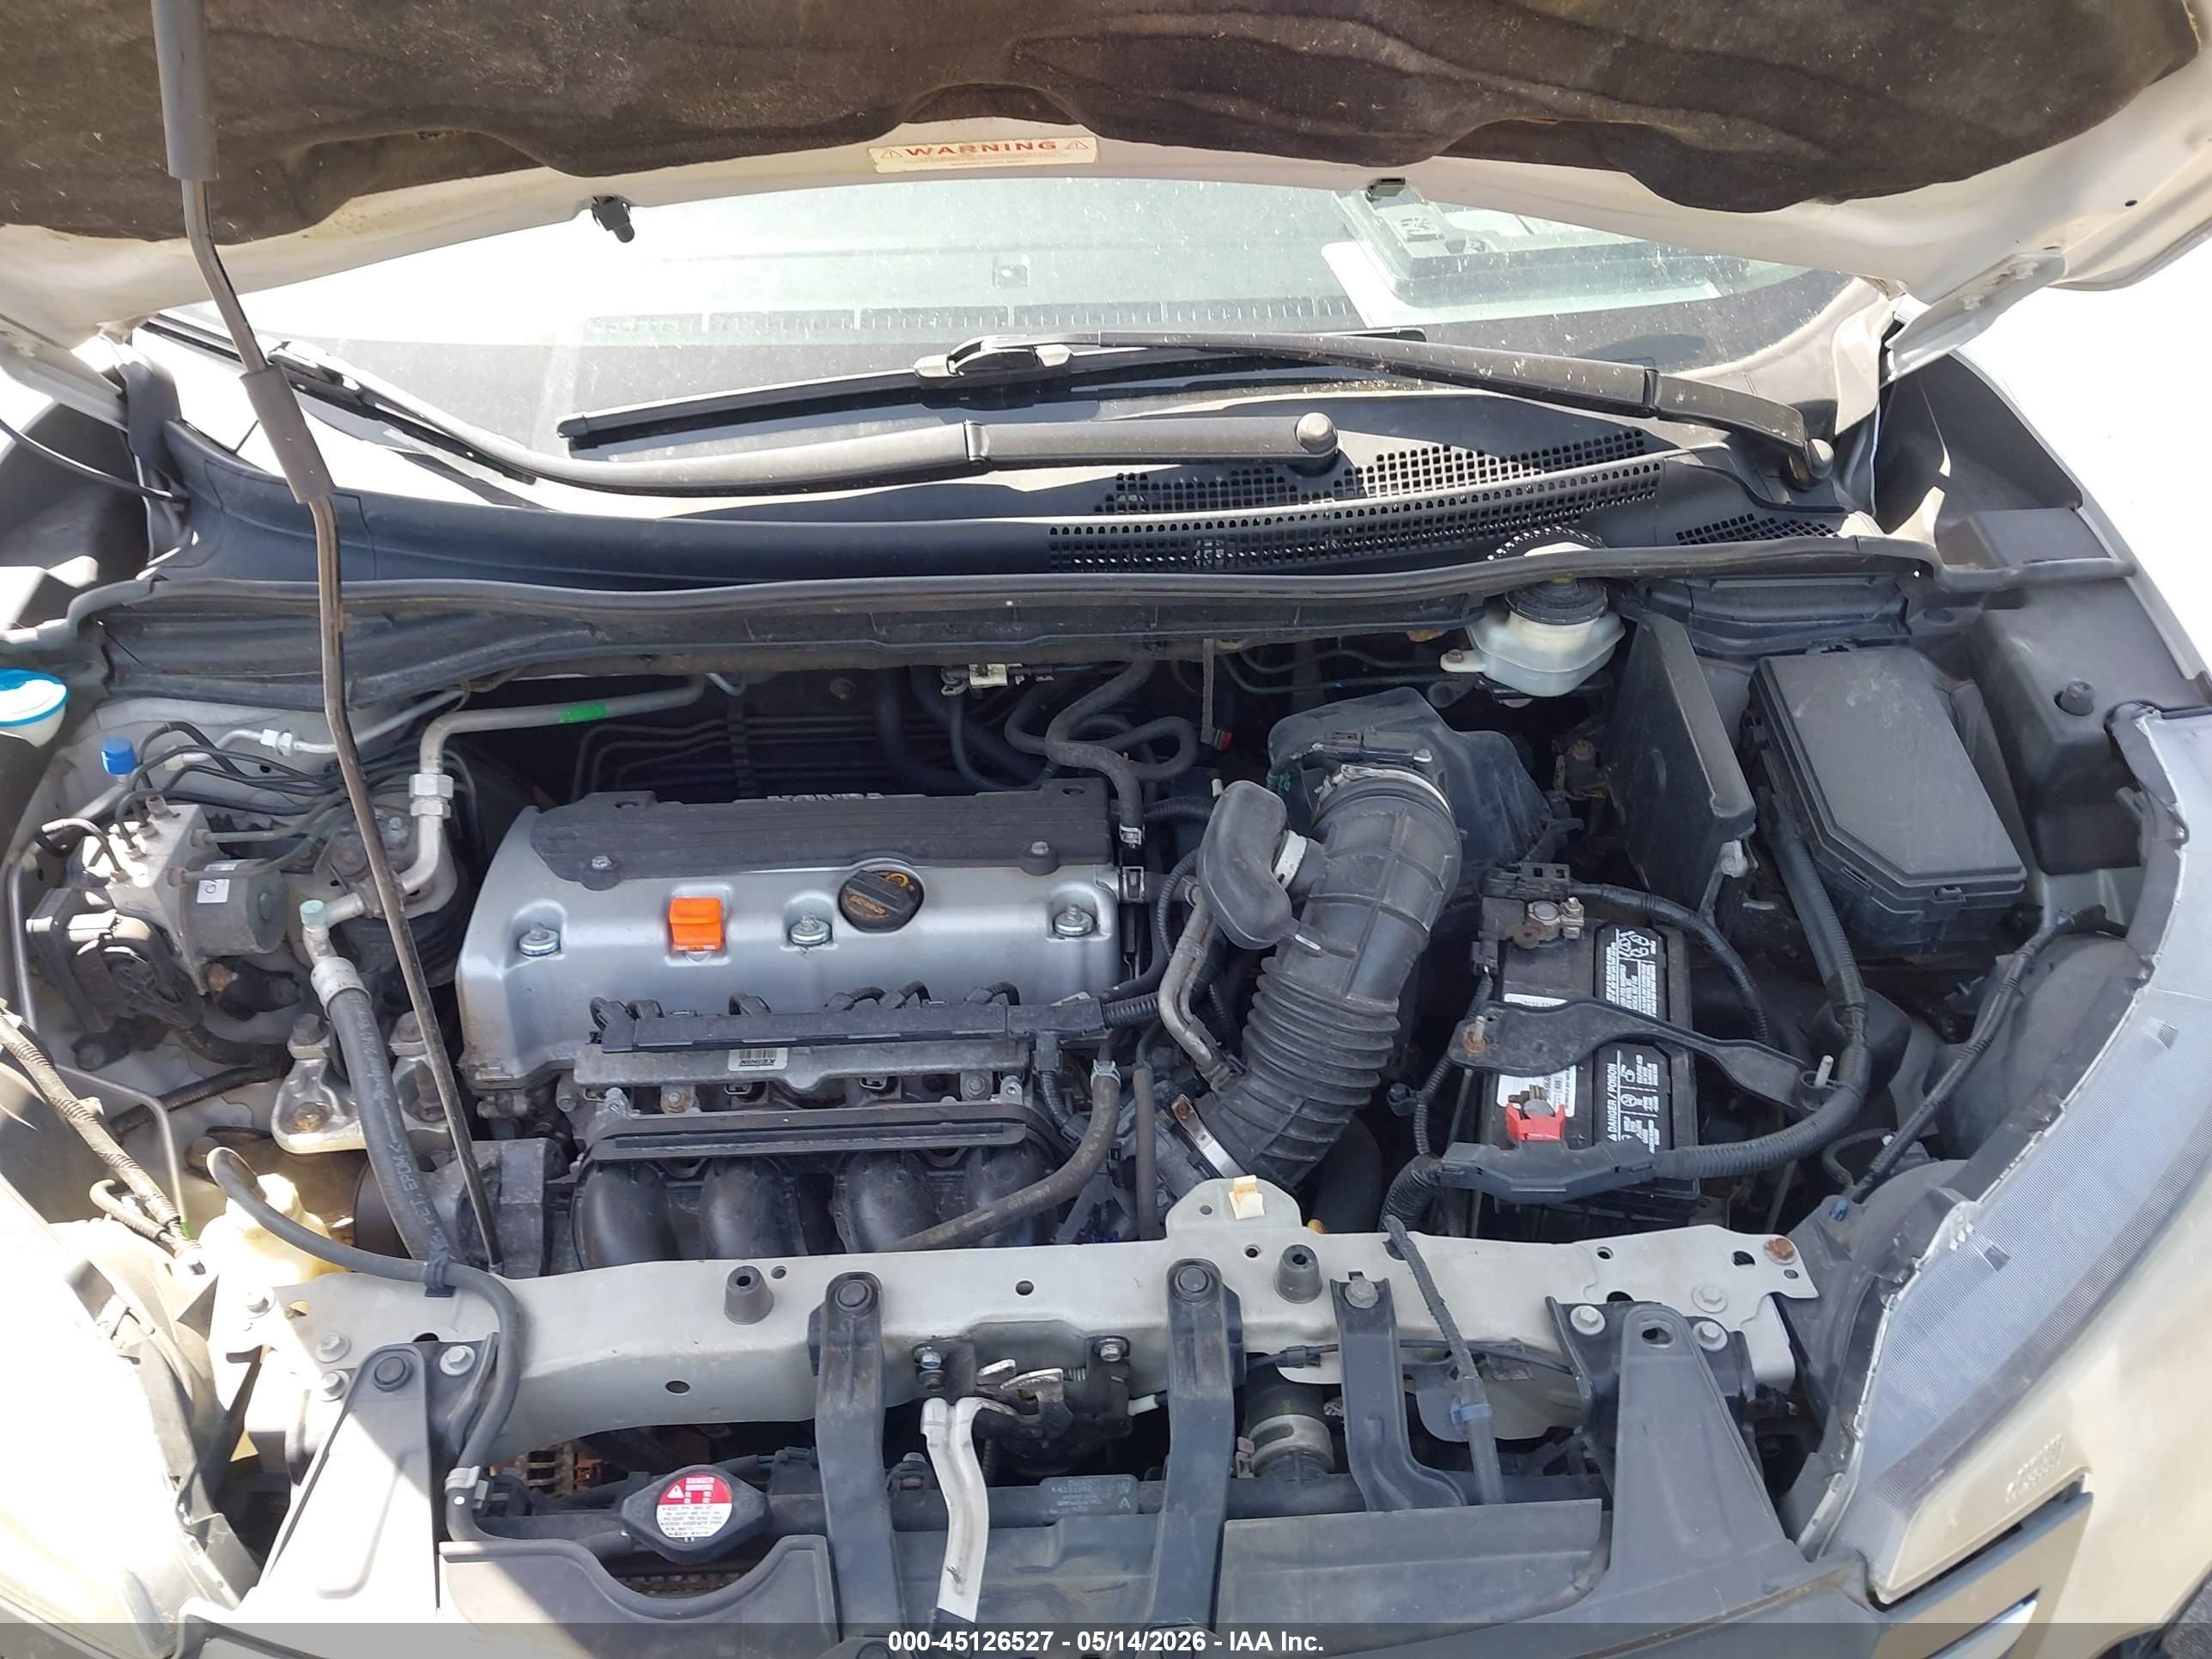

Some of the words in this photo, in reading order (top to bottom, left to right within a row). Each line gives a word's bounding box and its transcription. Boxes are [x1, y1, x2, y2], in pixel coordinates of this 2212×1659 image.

[905, 142, 1057, 156] WARNING
[1607, 1063, 1618, 1092] POISON
[1607, 1099, 1618, 1133] DANGER
